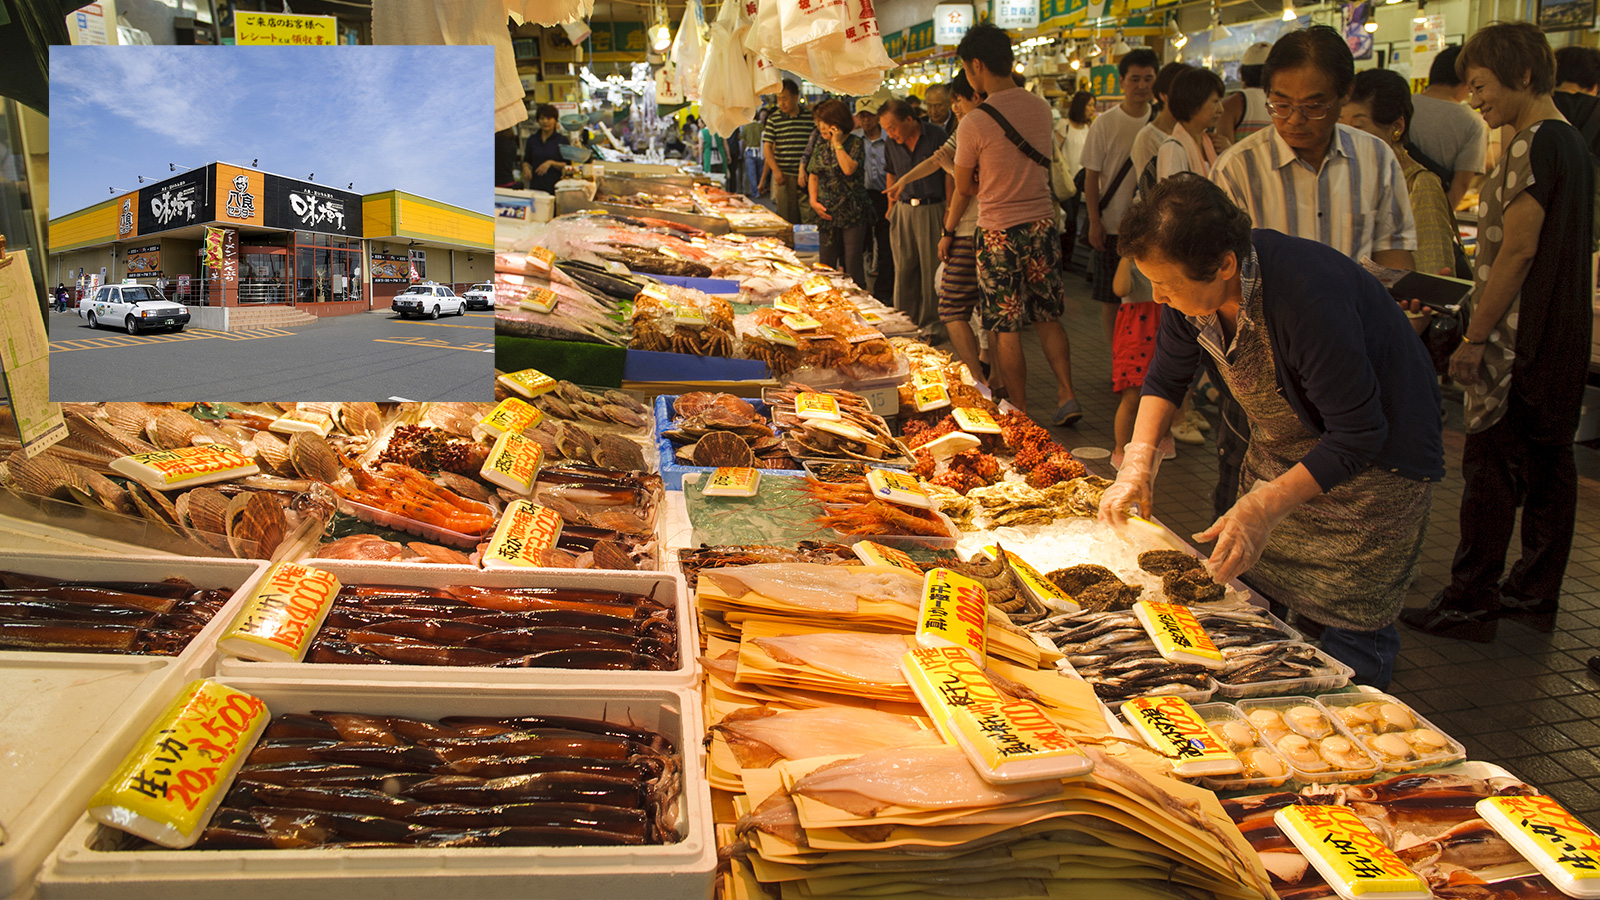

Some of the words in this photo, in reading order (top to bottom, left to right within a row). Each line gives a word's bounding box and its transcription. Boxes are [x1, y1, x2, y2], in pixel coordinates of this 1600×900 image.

[246, 16, 325, 30] ご来店のお客様へ
[227, 190, 255, 210] 八食
[227, 205, 255, 218] センター
[871, 392, 885, 408] 15
[912, 647, 953, 674] 八戸産
[129, 729, 189, 799] 生いか
[1323, 833, 1386, 878] 生いか
[1521, 819, 1600, 870] 生いか
